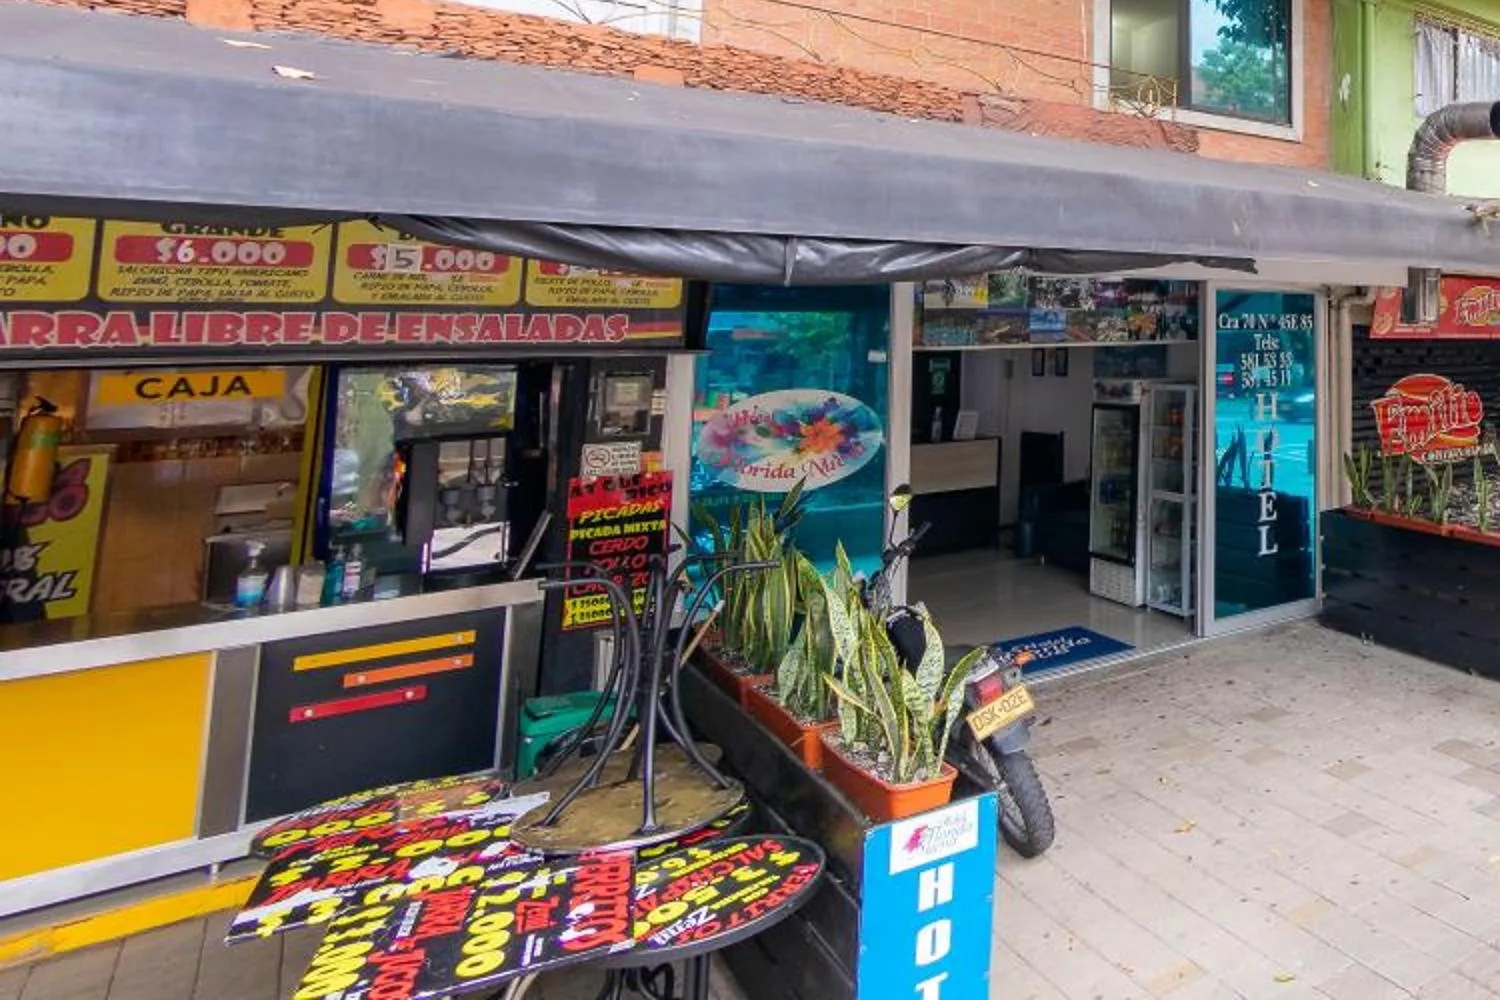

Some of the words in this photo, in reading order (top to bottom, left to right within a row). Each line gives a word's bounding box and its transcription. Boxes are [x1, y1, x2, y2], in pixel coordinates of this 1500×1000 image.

[0, 232, 37, 259] 0
[155, 236, 287, 264] $6.000
[370, 244, 496, 270] $5.000
[0, 311, 142, 348] RRA
[149, 311, 316, 347] LIBRE
[321, 312, 391, 344] DE
[395, 312, 630, 345] ENSALADAS
[1218, 313, 1240, 330] Cra
[134, 375, 252, 400] CAJA
[1254, 392, 1279, 557] HOTEL
[578, 499, 664, 525] PICADAS
[570, 525, 621, 540] PICADA
[623, 519, 668, 535] MIXTA
[589, 535, 650, 556] CERDO
